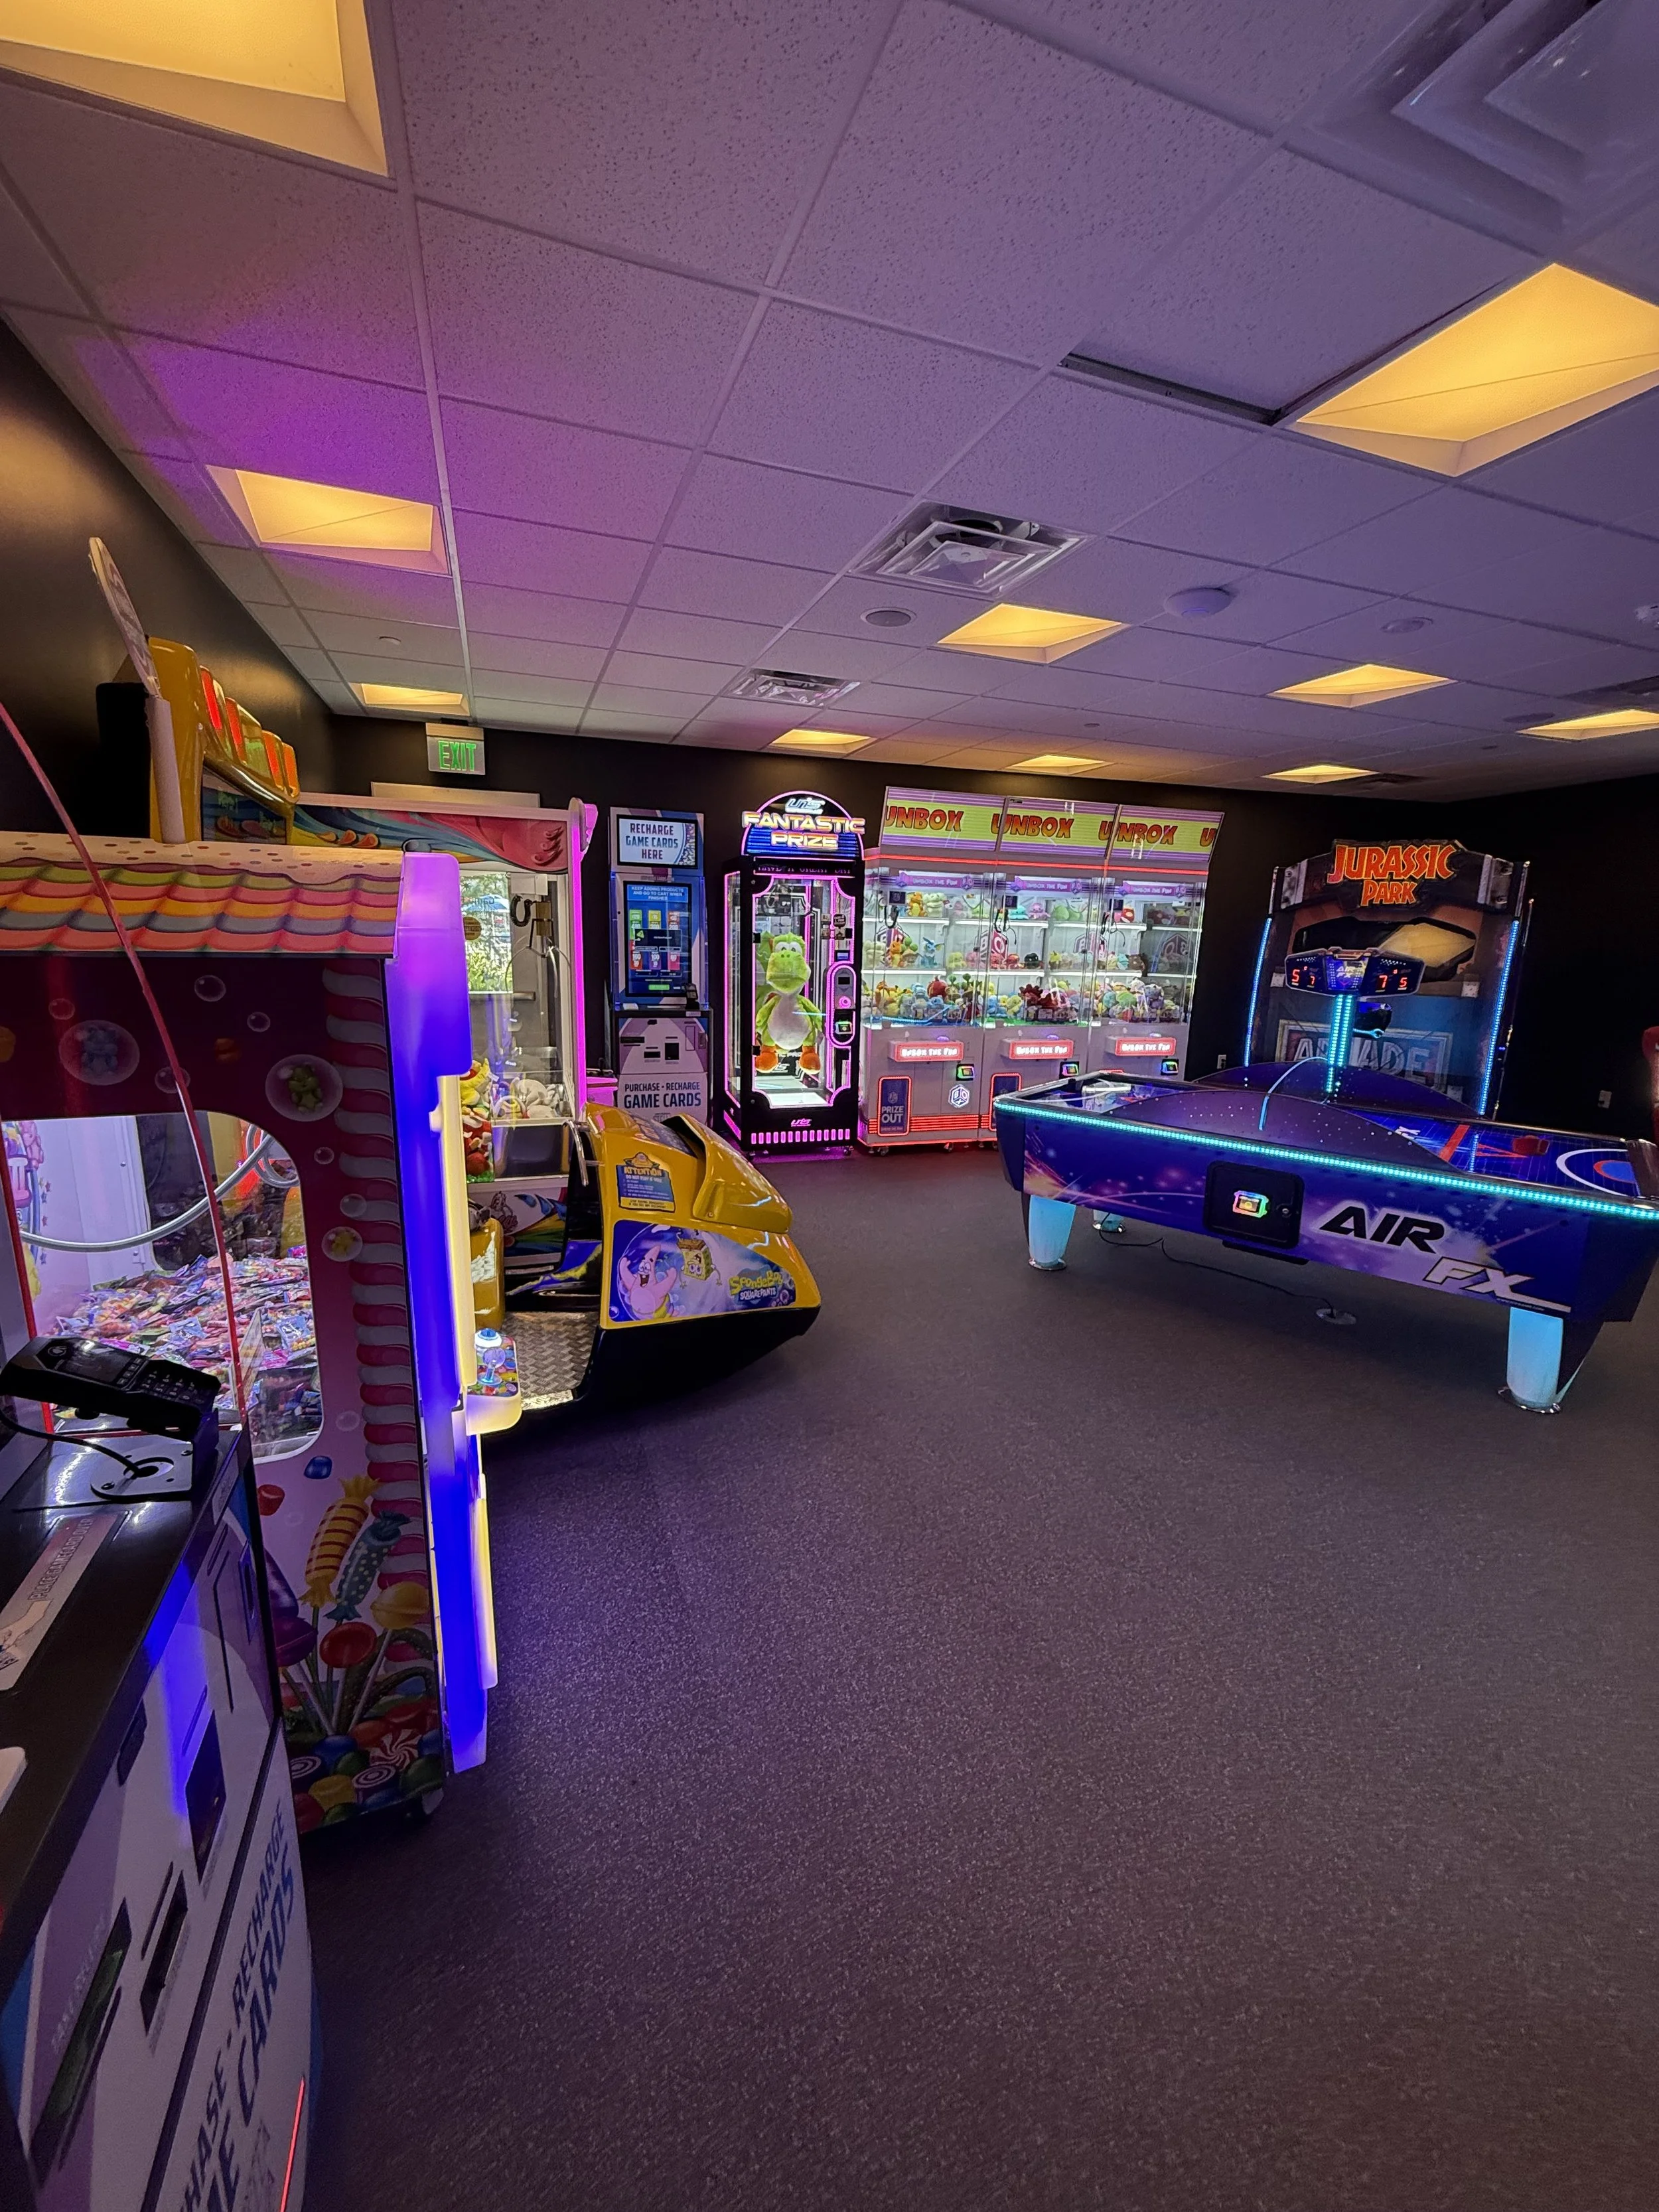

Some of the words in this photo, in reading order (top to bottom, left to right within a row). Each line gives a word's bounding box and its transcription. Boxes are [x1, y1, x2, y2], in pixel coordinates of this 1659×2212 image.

[438, 740, 476, 772] EXIT
[630, 822, 674, 836] RECHARGE
[742, 811, 865, 834] FANTASTIC
[885, 805, 964, 832] UNBOX
[991, 813, 1074, 838] UNBOX
[1098, 820, 1178, 845] UNBOX
[626, 835, 648, 847] GAME
[651, 837, 678, 849] CARDS
[770, 830, 838, 850] PRIZE
[641, 848, 663, 860] HERE
[1327, 844, 1457, 884] JURASSIC
[1360, 880, 1417, 907] PARK
[1291, 969, 1300, 982] 5
[1310, 976, 1315, 985] 7
[1378, 975, 1388, 988] 7
[1399, 977, 1407, 988] 5
[1294, 1037, 1430, 1086] AADE
[624, 1082, 660, 1092] PURCHASE
[666, 1082, 700, 1090] RECHARGE
[624, 1094, 660, 1109] GAME
[664, 1092, 701, 1108] CARDS
[881, 1114, 903, 1124] OUT
[624, 1166, 662, 1177] ATTENTION
[1319, 1205, 1445, 1254] AIR
[1422, 1256, 1563, 1310] FX
[740, 1287, 776, 1300] SQUAREPANTS
[27, 1576, 59, 1599] PLACE
[232, 1797, 284, 2028] RECHARGE
[238, 1841, 293, 2127] CARDS
